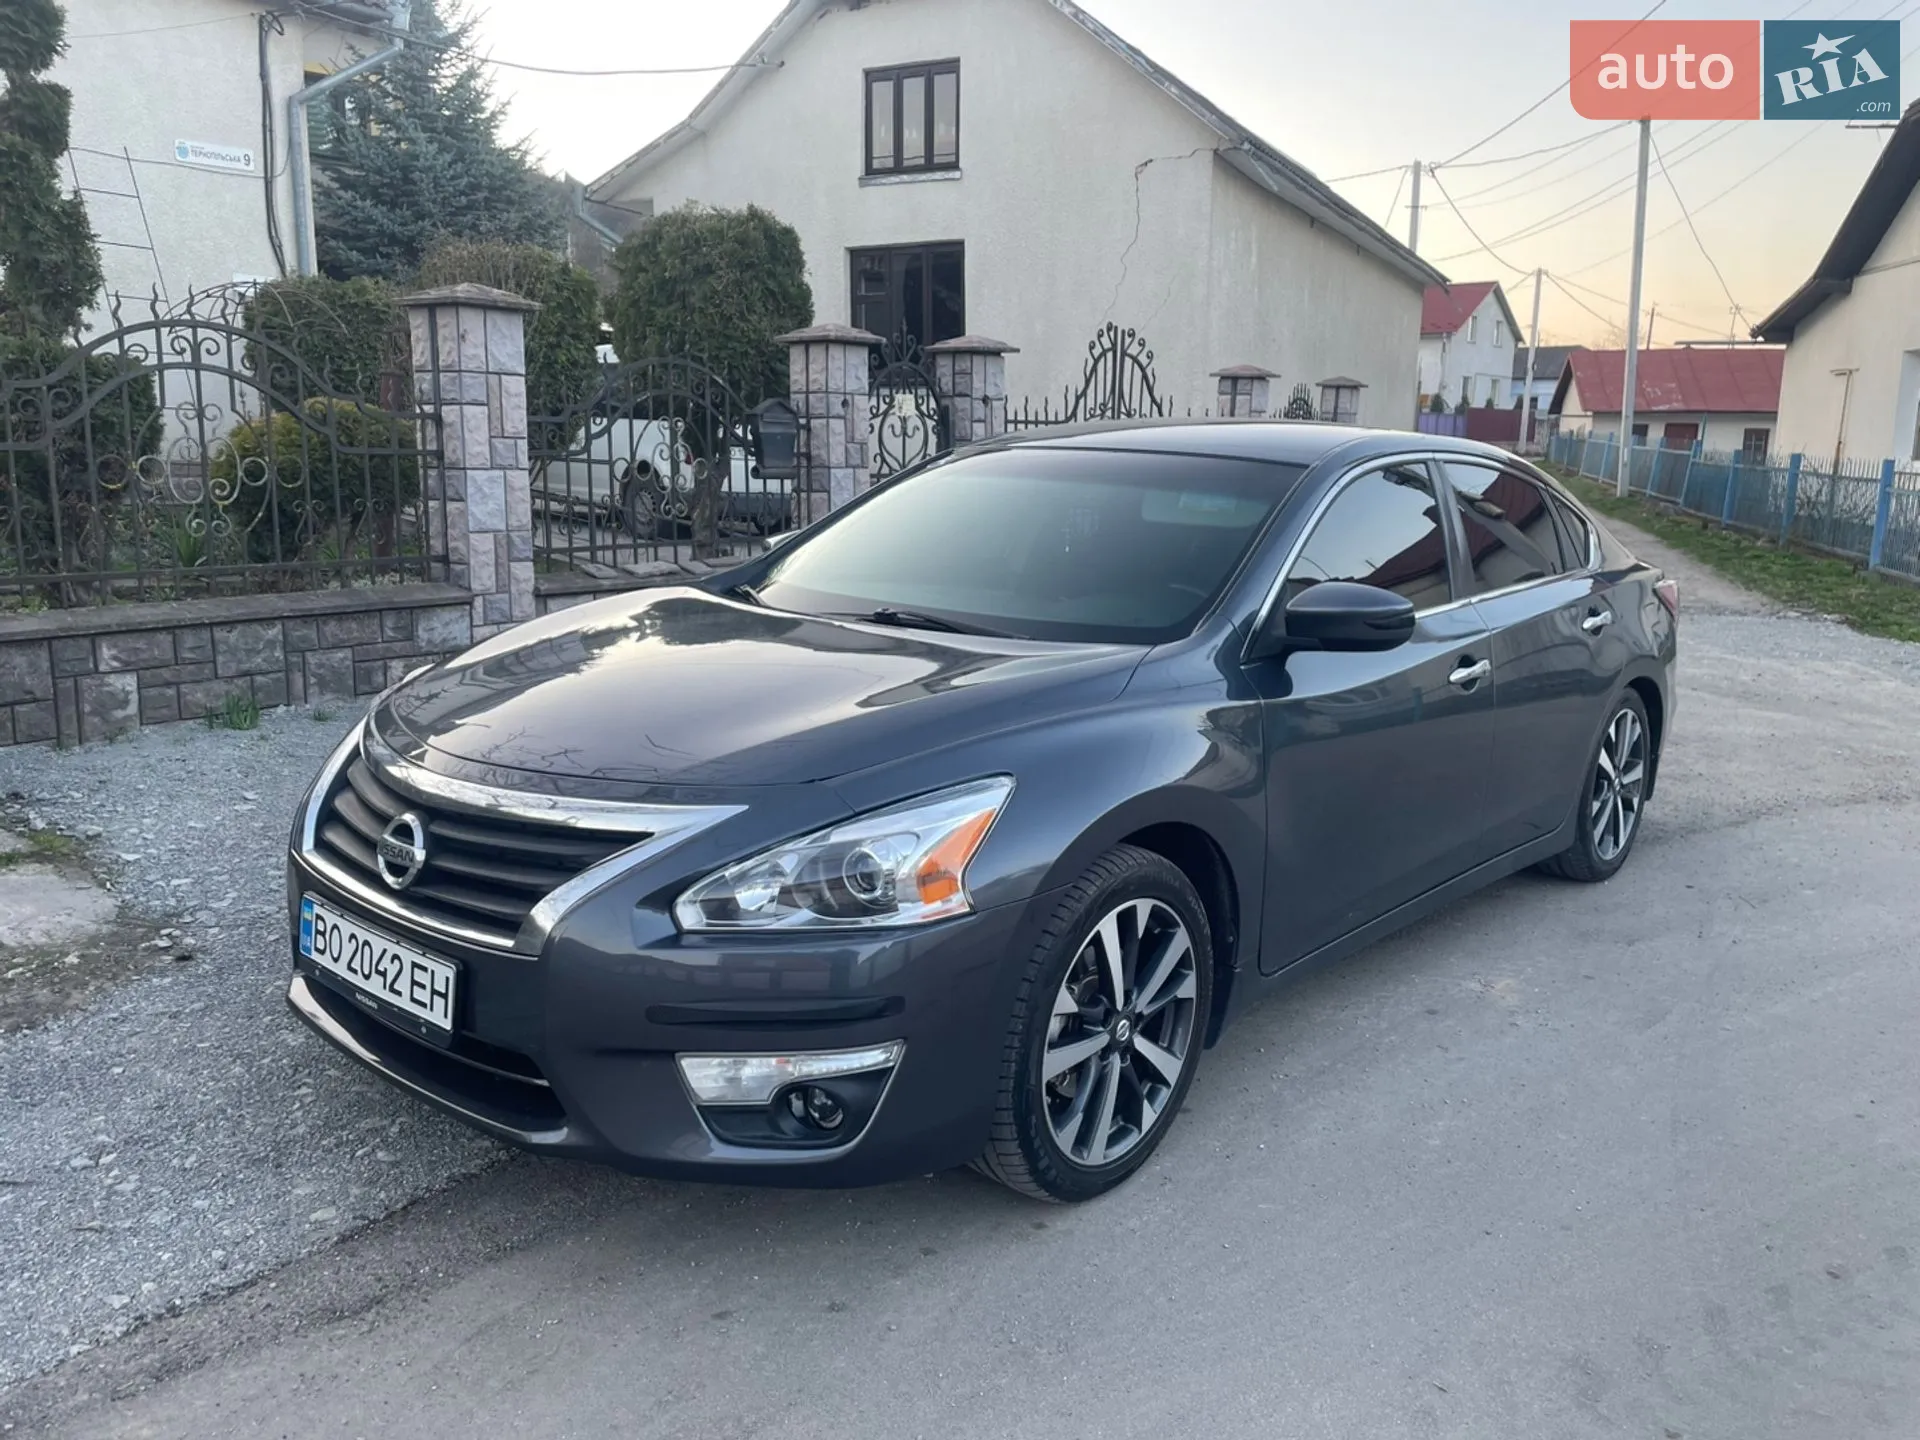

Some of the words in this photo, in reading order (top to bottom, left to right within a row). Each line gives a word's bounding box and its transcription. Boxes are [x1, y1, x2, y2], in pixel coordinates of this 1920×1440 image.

[243, 153, 252, 167] 9
[313, 912, 343, 964] BO
[346, 932, 404, 998] 2042
[409, 960, 450, 1020] EH
